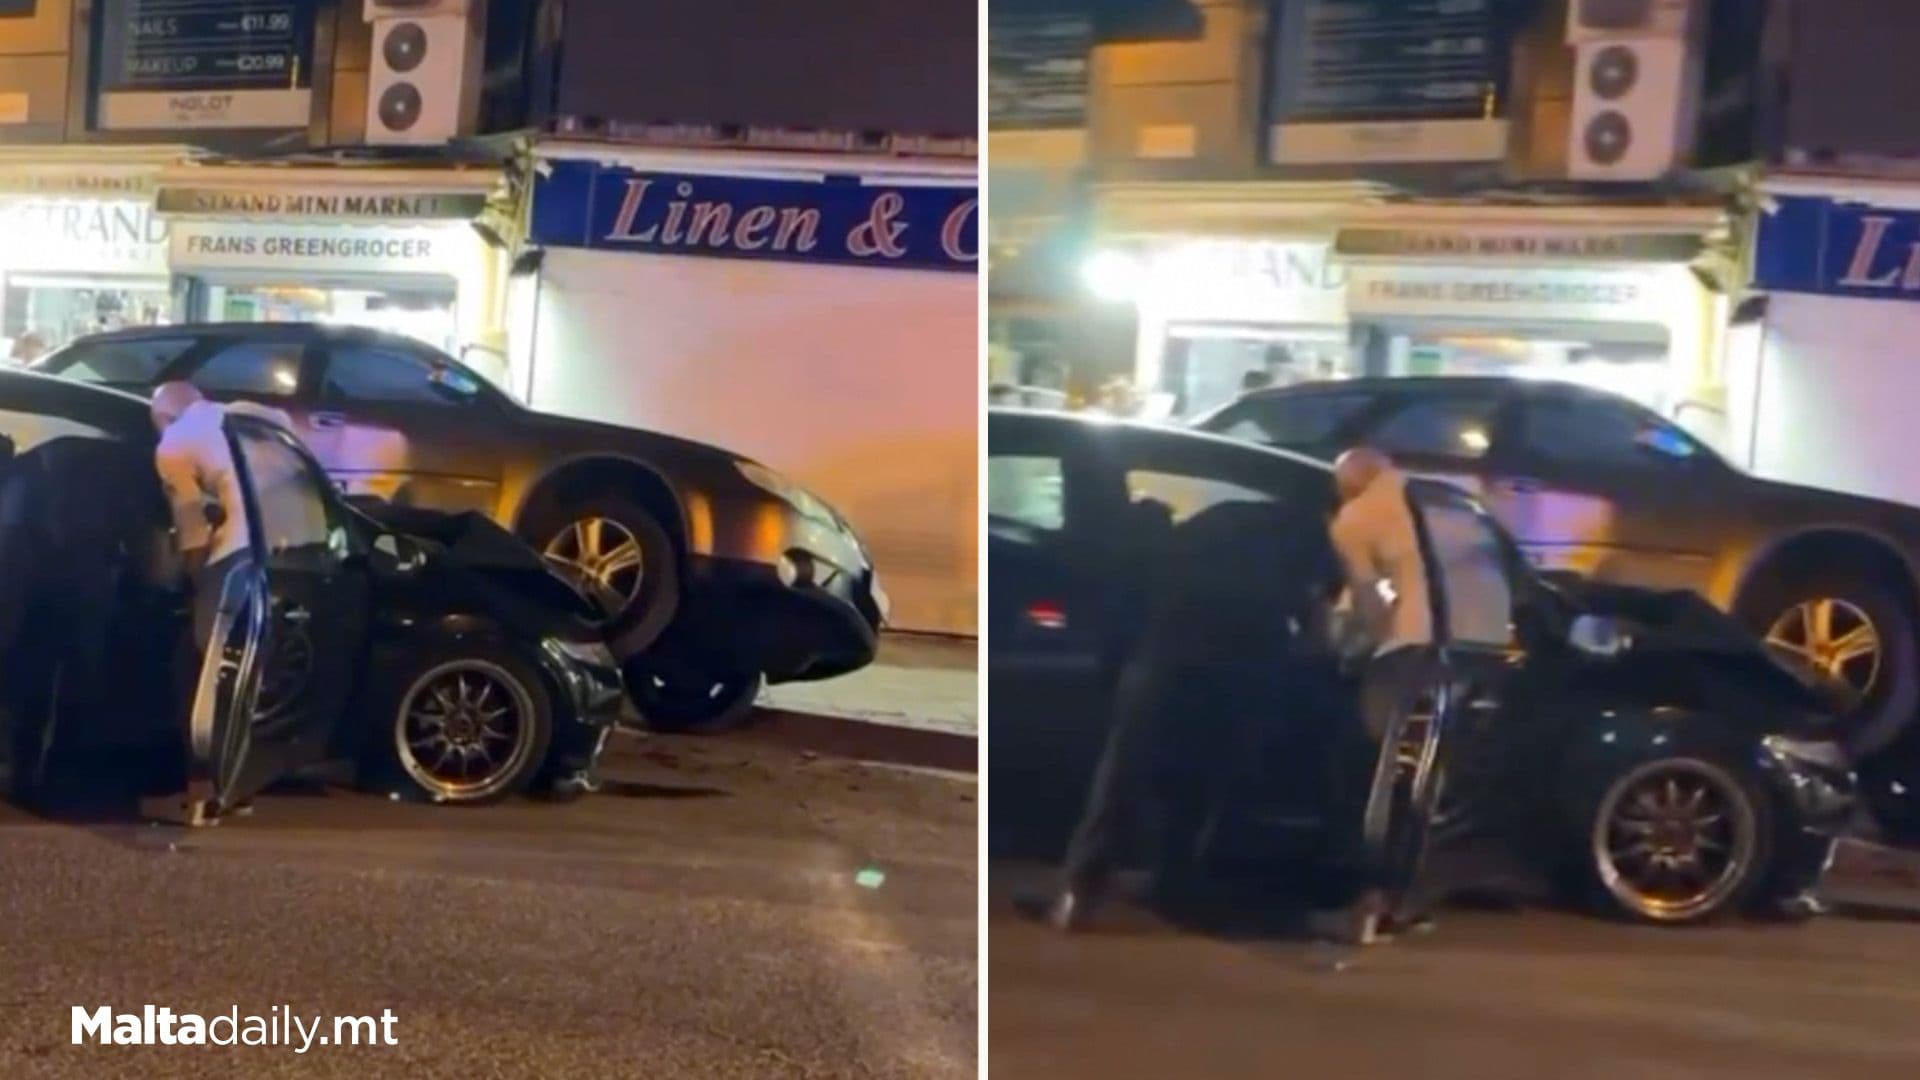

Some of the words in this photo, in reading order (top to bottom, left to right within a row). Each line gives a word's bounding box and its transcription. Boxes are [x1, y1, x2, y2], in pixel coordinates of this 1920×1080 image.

[20, 202, 171, 244] TRAND
[604, 177, 822, 252] Linen
[846, 192, 909, 258] &
[187, 234, 256, 255] FRANS
[262, 236, 432, 259] GREENGROCER
